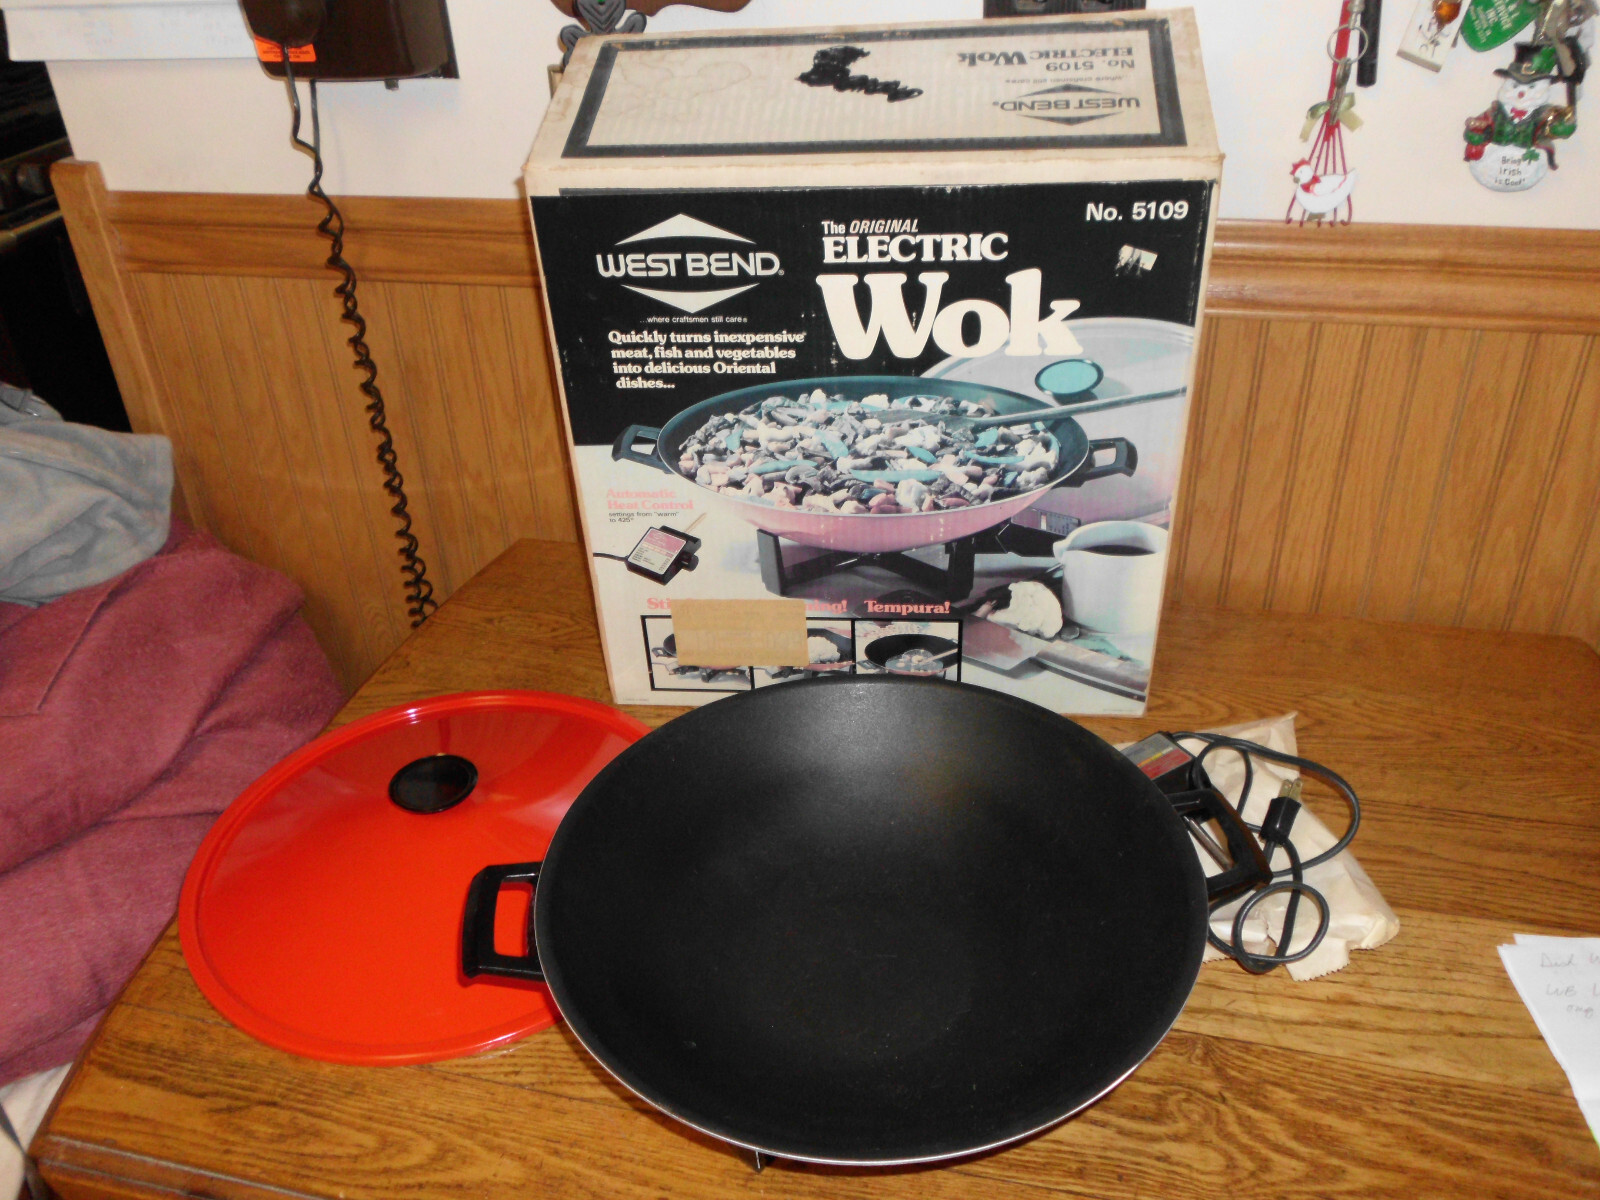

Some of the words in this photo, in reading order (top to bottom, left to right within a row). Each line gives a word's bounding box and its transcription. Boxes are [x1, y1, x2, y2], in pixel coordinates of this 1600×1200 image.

[957, 51, 1028, 67] Wok
[1030, 47, 1133, 59] ELECTRIC
[1046, 60, 1094, 71] 5109
[1073, 97, 1141, 109] WEST
[1085, 202, 1123, 222] No.
[1132, 200, 1189, 220] 5109
[821, 219, 846, 235] The
[849, 218, 919, 235] ORIGINAL
[822, 233, 1009, 264] ELECTRIC
[596, 253, 682, 278] WEST
[816, 268, 1084, 360] Wok
[608, 330, 667, 345] Quickly
[669, 332, 711, 343] turns
[714, 330, 805, 344] inexpensive
[611, 347, 653, 360] meat,
[654, 346, 683, 359] fish
[684, 346, 714, 359] and
[716, 346, 796, 360] vegetables
[613, 361, 642, 374] into
[644, 361, 711, 374] delicious
[713, 361, 776, 374] Oriental
[616, 376, 675, 389] dishes...
[607, 488, 676, 499] Automatic
[607, 500, 639, 510] Heat
[640, 500, 694, 510] Control
[864, 600, 950, 616] Tempura!
